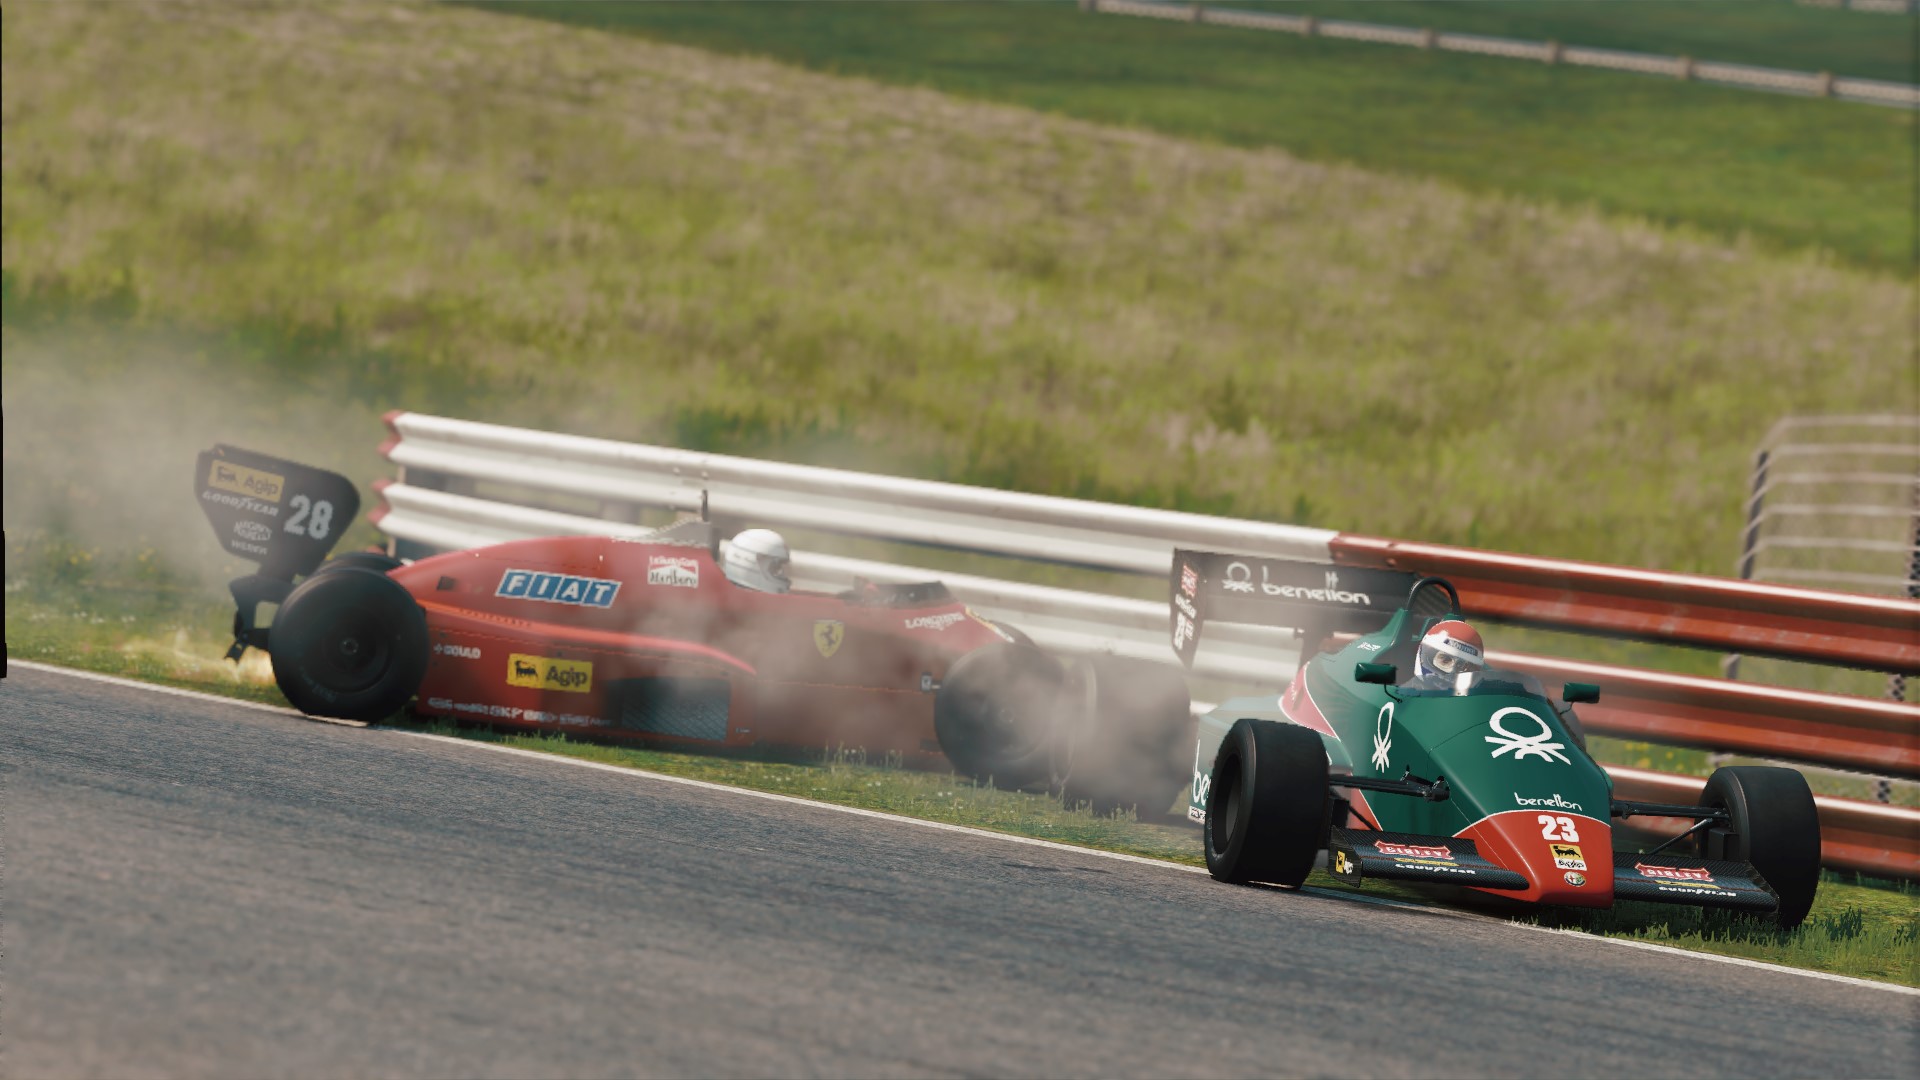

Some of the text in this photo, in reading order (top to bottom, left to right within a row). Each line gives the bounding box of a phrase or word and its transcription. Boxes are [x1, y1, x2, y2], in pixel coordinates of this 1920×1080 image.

[202, 490, 279, 517] GOODYEAR
[283, 494, 333, 540] 28
[506, 574, 611, 603] FIAT
[1261, 565, 1372, 605] benetton
[546, 666, 588, 687] Agip
[1514, 792, 1583, 812] benetton
[1537, 814, 1580, 843] 23
